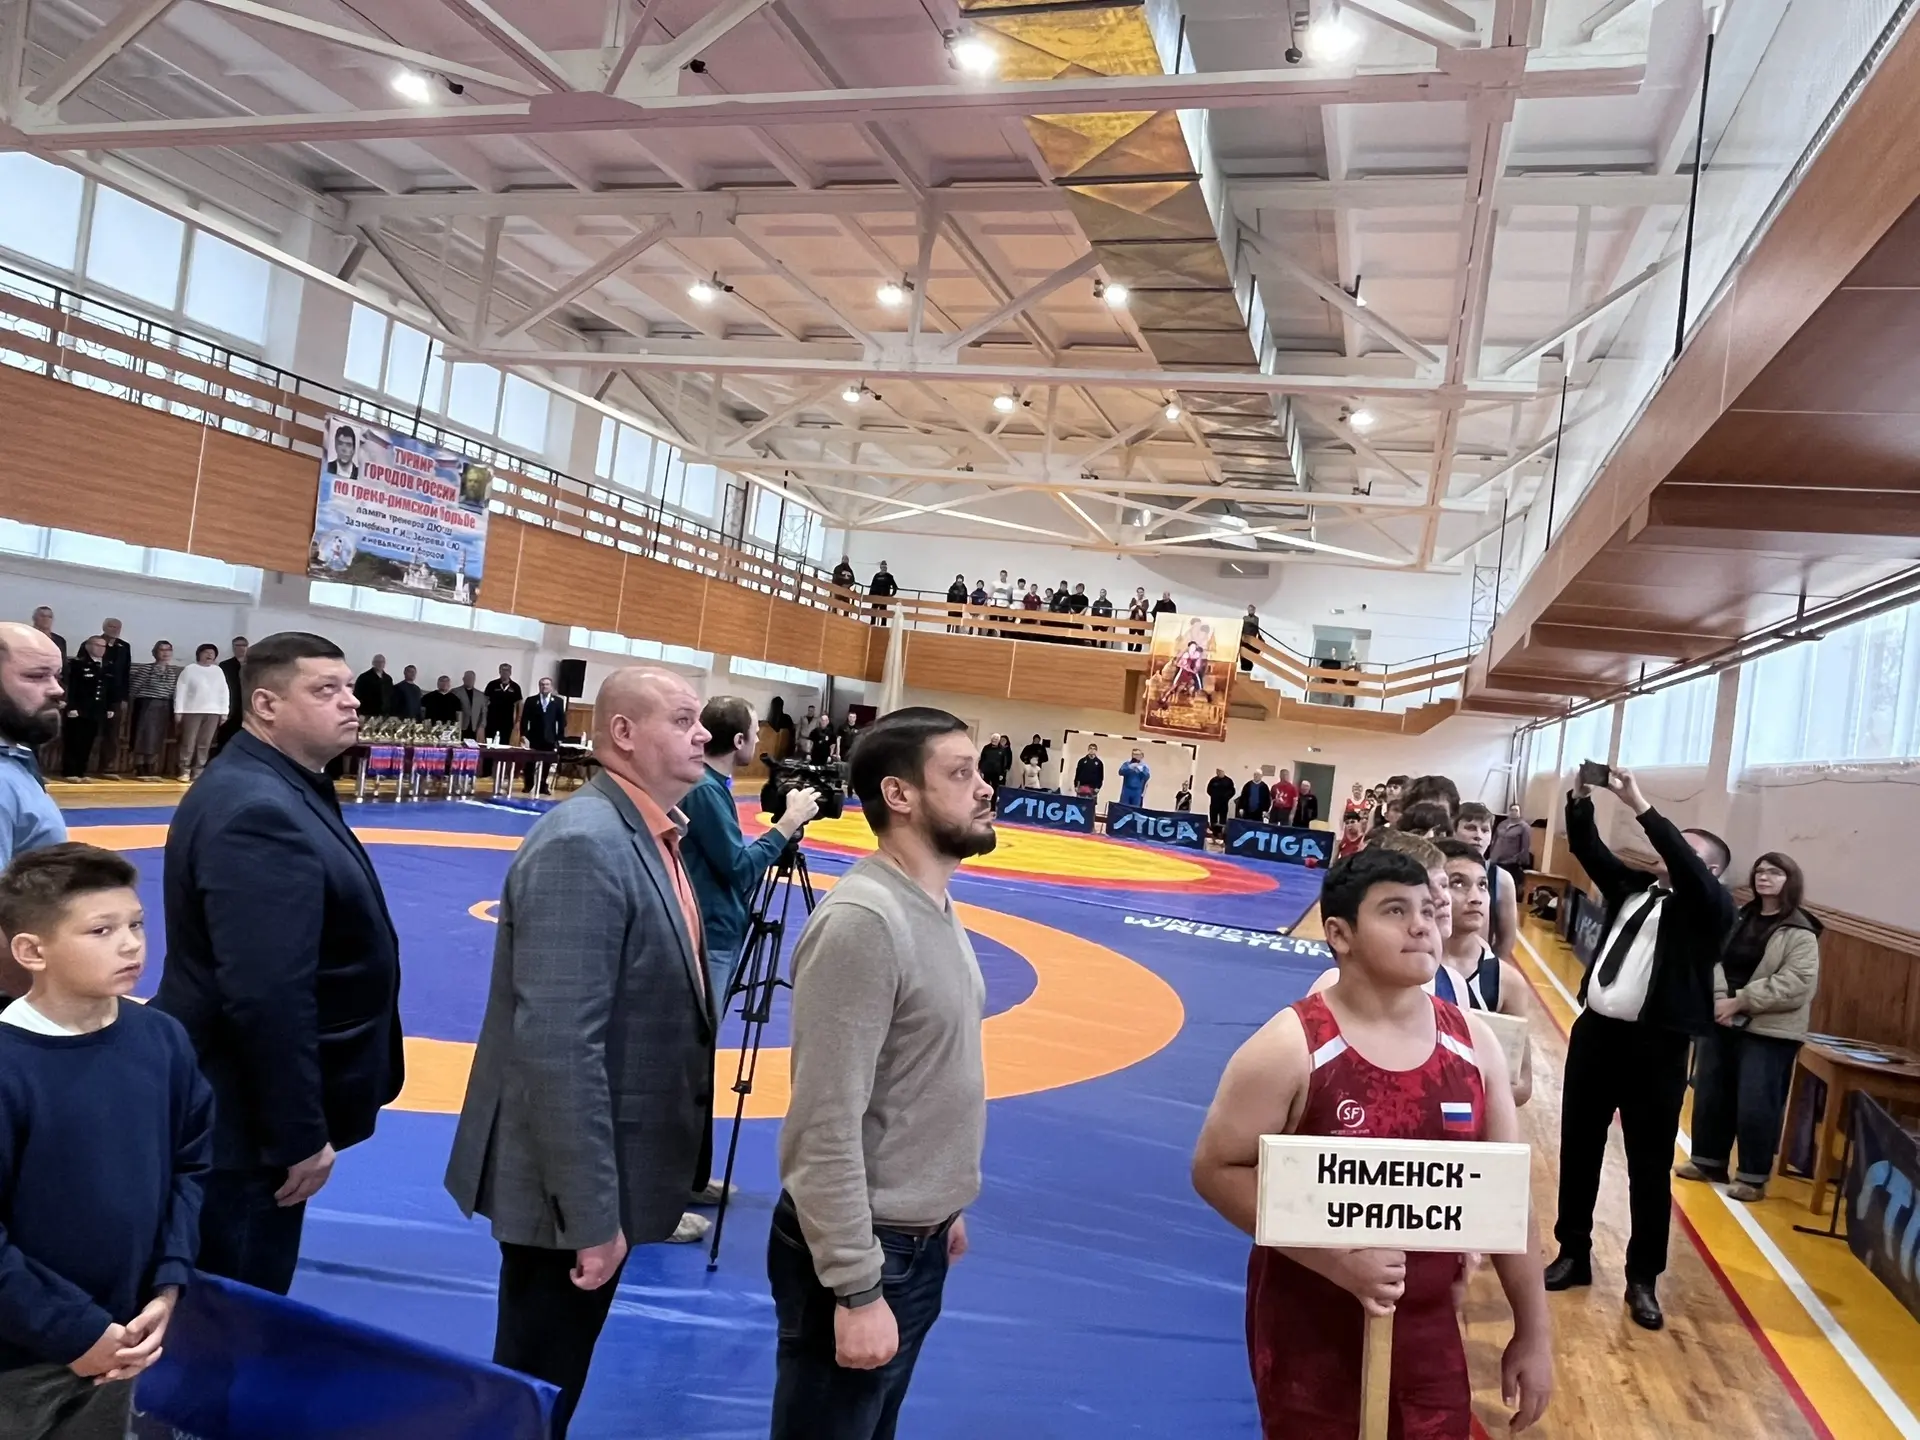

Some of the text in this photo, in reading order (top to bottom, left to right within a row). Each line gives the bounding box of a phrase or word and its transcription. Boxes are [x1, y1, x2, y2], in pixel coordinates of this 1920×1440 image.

[394, 448, 434, 473] ТУРНИР
[364, 462, 456, 502] ГОРОДОВ РОССИИ
[356, 507, 386, 519] памяти
[389, 514, 425, 529] тренеров
[367, 537, 416, 554] невьянских
[417, 546, 445, 560] борцов
[1004, 797, 1085, 825] STIGA
[1113, 811, 1198, 842] STIGA
[1232, 831, 1324, 860] STIGA
[1123, 916, 1334, 958] WRESTLIN
[1343, 1106, 1361, 1120] SF
[1327, 1202, 1462, 1231] УРАЛЬСК
